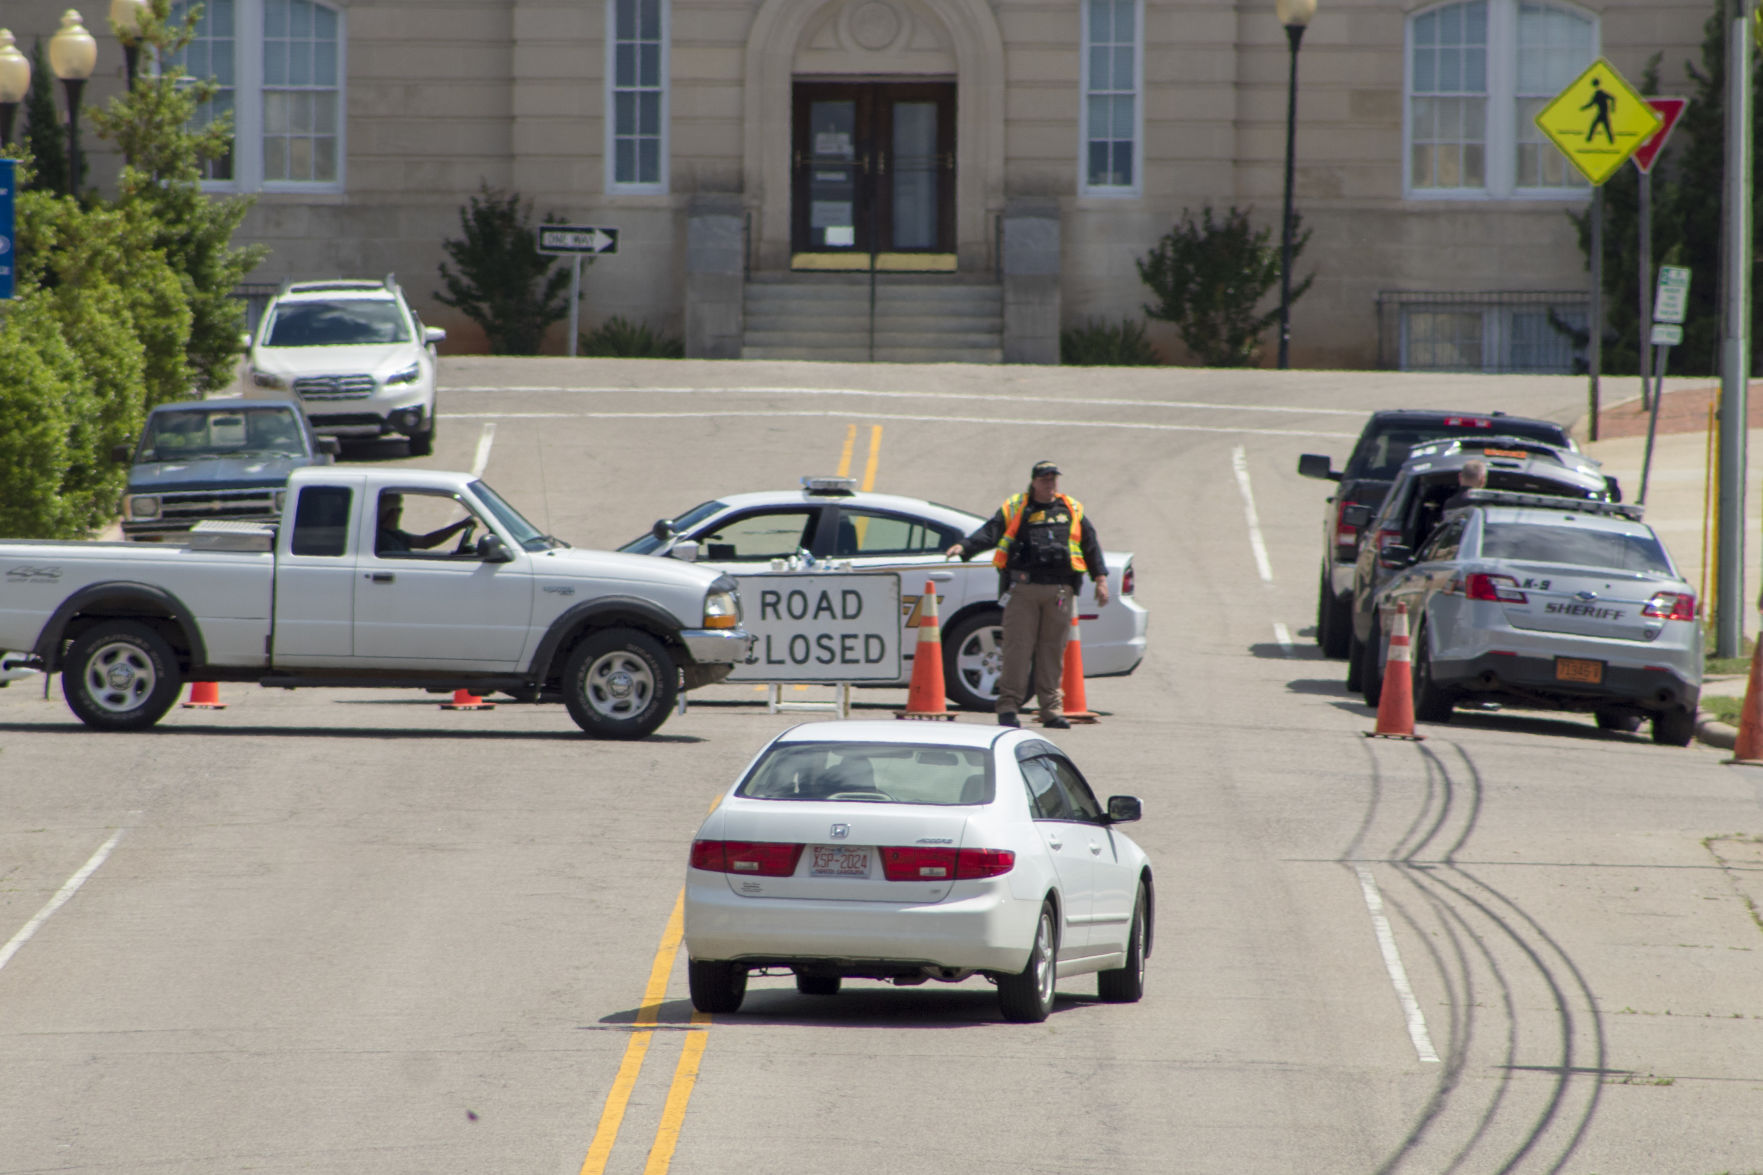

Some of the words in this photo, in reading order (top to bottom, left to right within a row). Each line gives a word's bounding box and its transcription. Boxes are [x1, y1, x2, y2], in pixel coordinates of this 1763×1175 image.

[547, 233, 567, 246] ONE
[572, 234, 594, 247] WAY
[1524, 578, 1551, 590] K-9
[760, 589, 863, 621] ROAD
[1545, 603, 1626, 620] SHERIFF
[812, 853, 868, 869] XSP-2024
